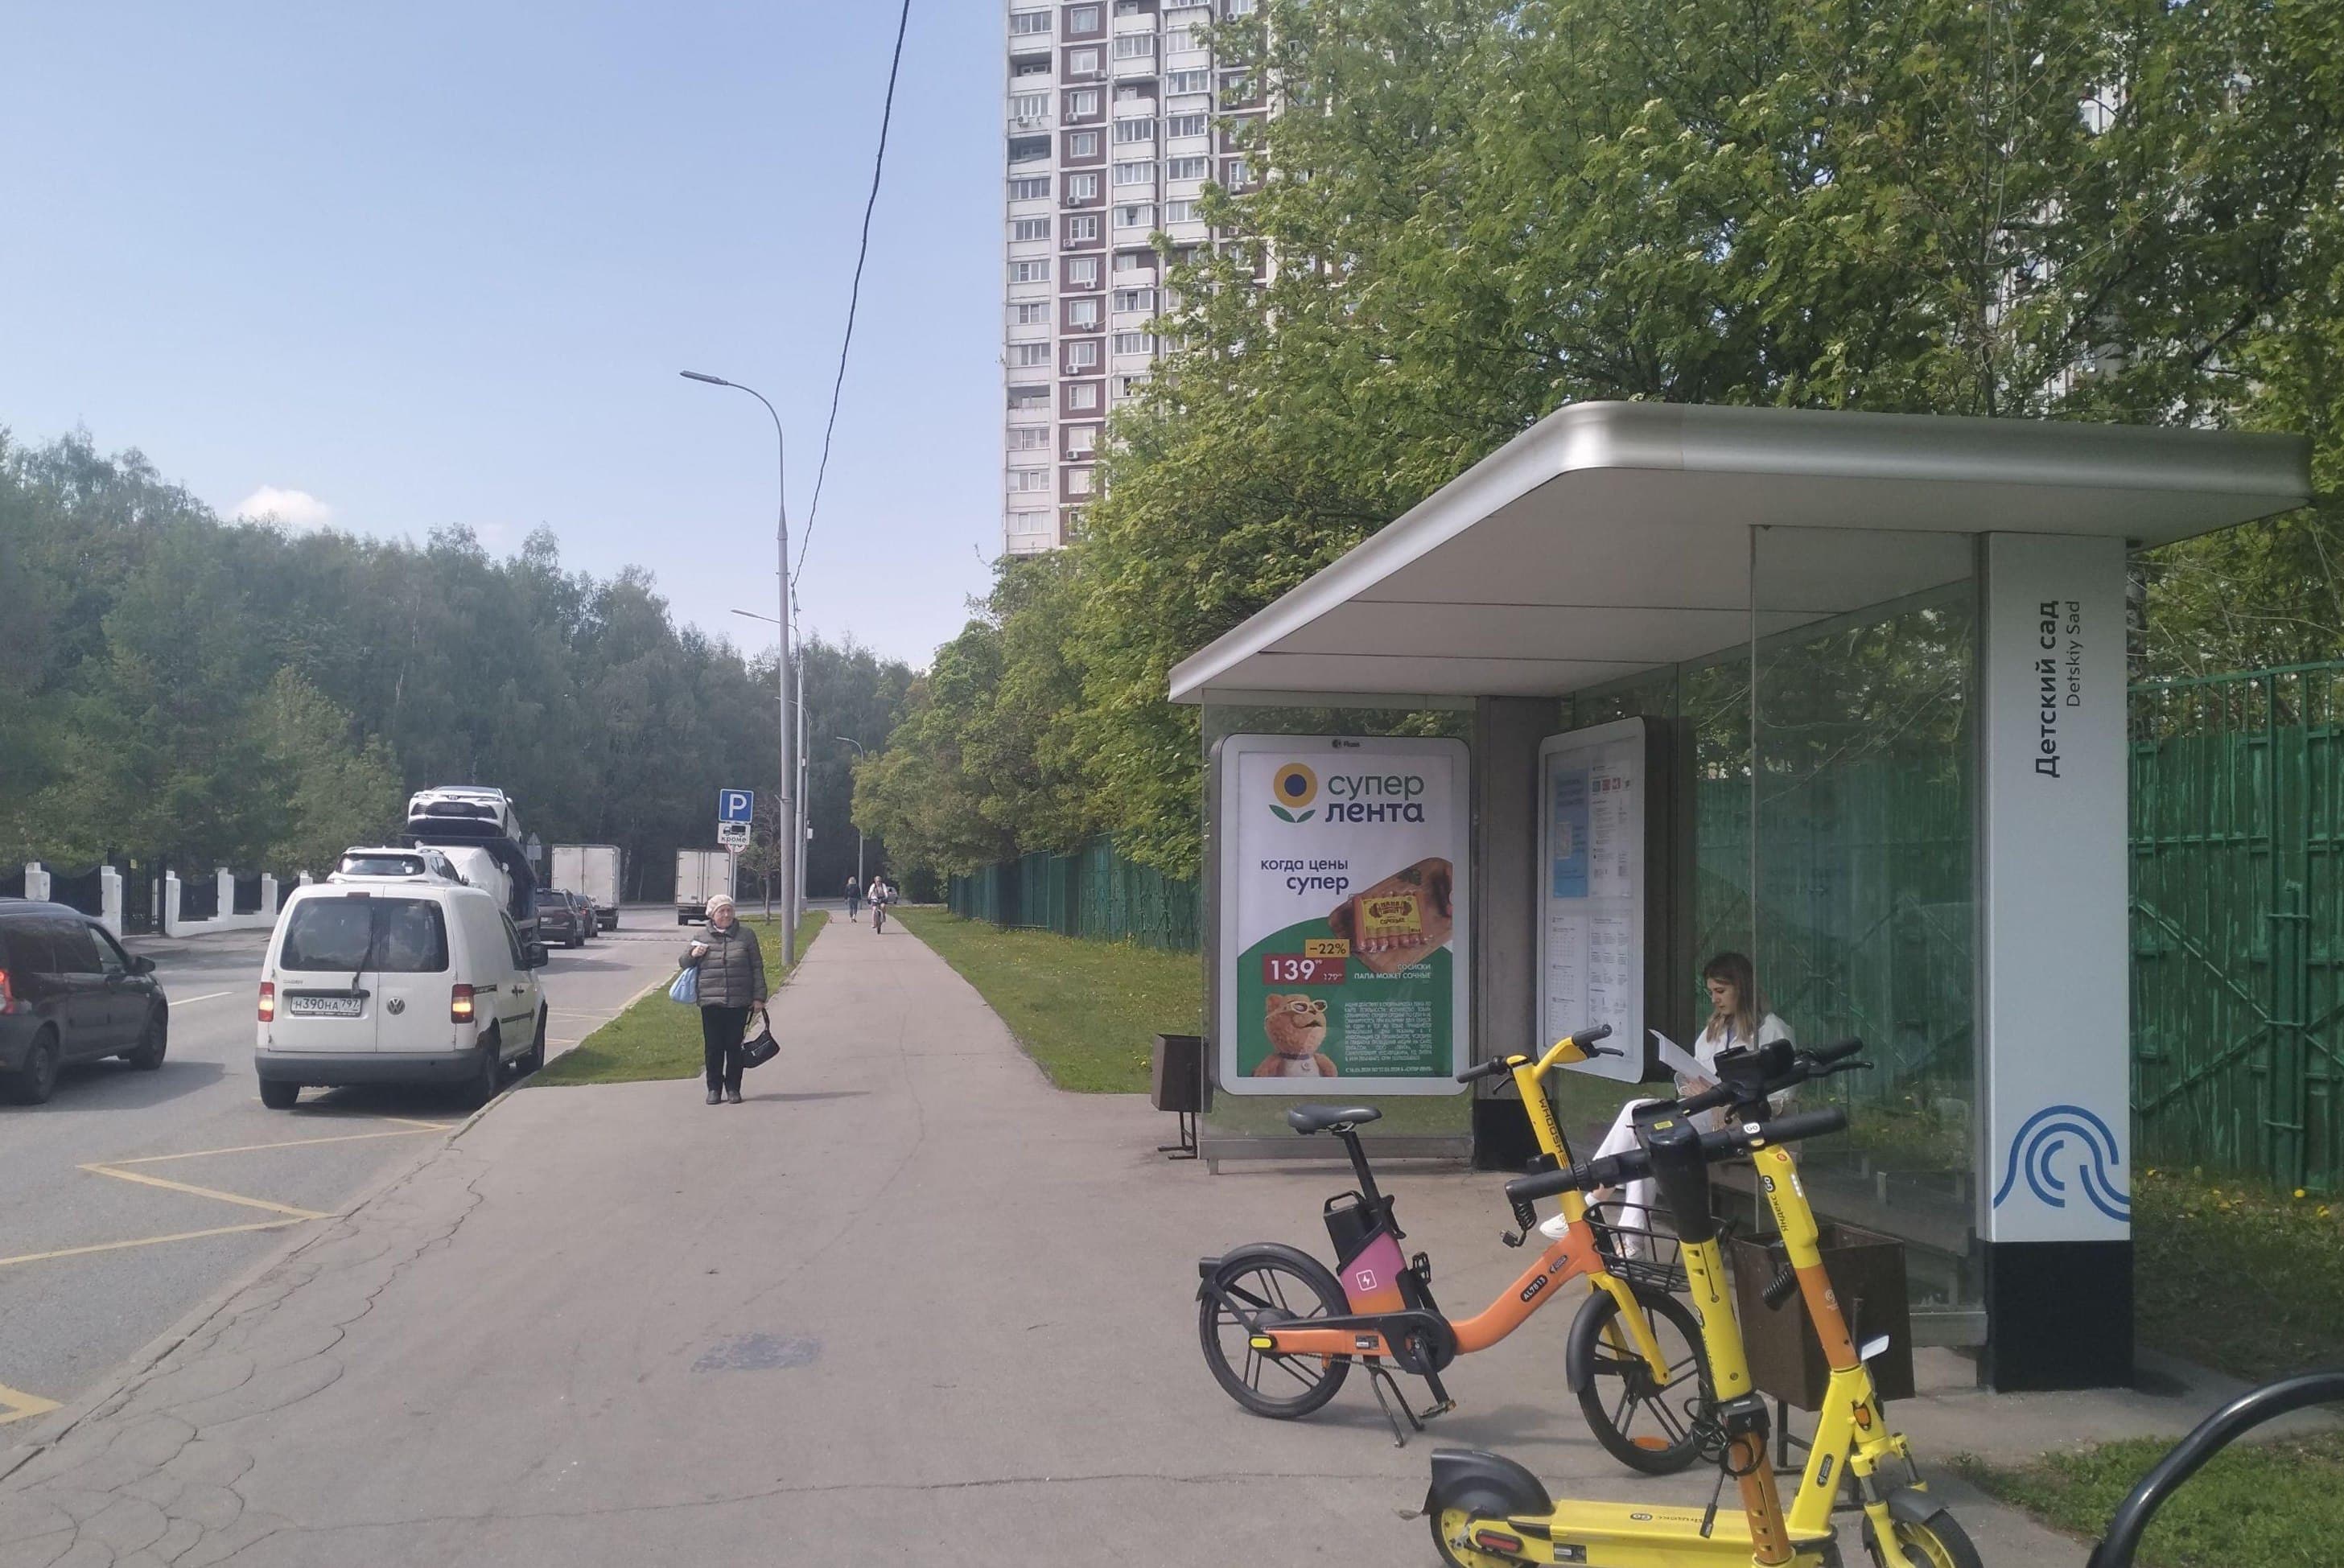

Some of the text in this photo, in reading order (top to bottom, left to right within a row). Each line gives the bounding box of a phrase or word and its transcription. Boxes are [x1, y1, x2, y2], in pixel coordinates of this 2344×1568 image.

[2065, 601, 2084, 706] Detskiy Sad
[2035, 600, 2060, 778] Детский сад
[1328, 774, 1425, 800] супер
[728, 793, 747, 818] P
[1324, 802, 1425, 823] лента
[1260, 858, 1349, 874] когда цены
[1286, 875, 1349, 895] супер
